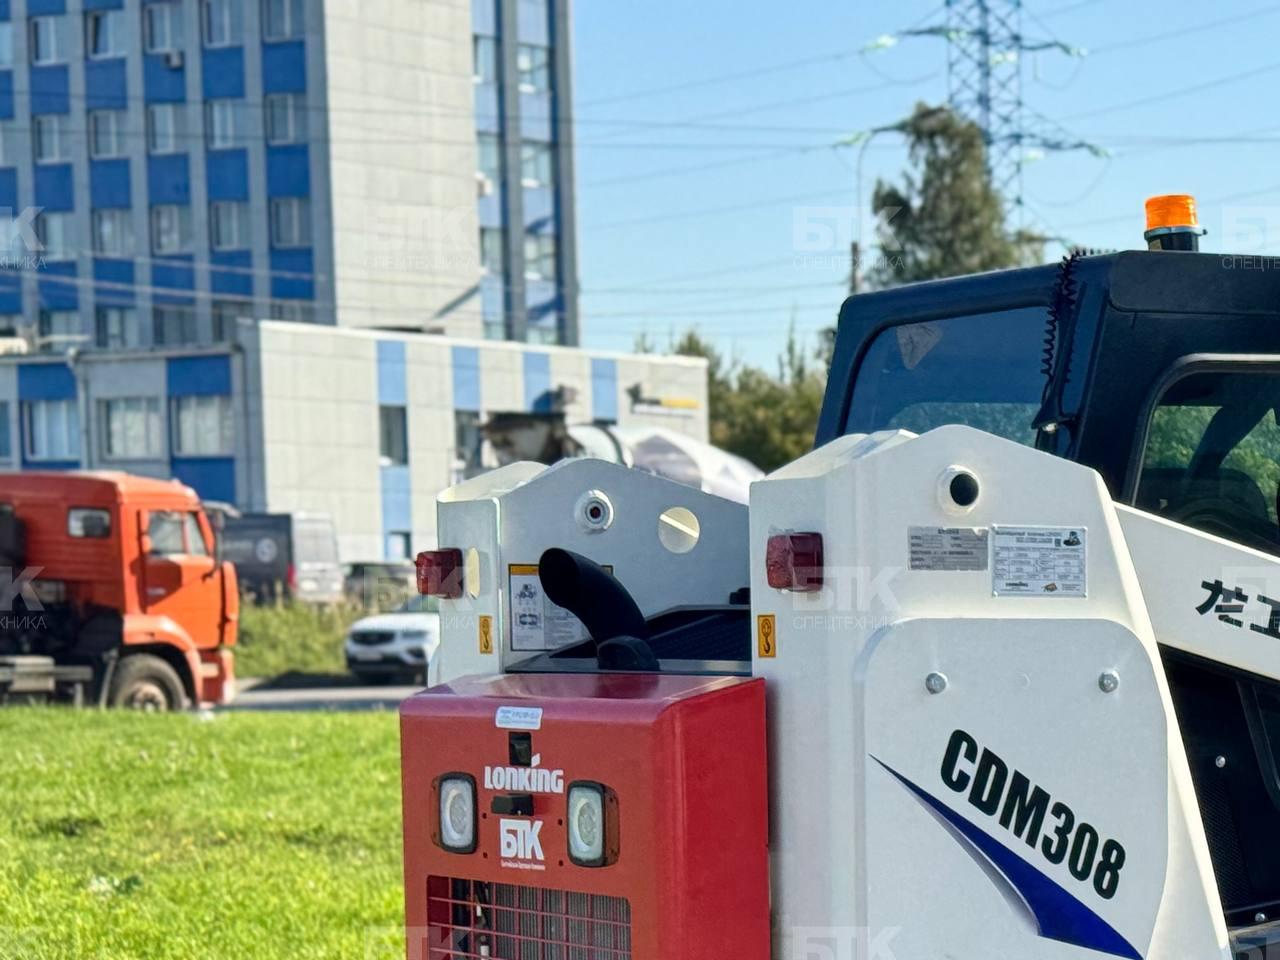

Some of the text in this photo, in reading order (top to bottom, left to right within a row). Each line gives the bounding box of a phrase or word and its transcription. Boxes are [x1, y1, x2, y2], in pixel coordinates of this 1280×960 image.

[484, 753, 565, 793] LONKING
[940, 729, 1127, 900] CDM308
[500, 818, 545, 861] БТК
